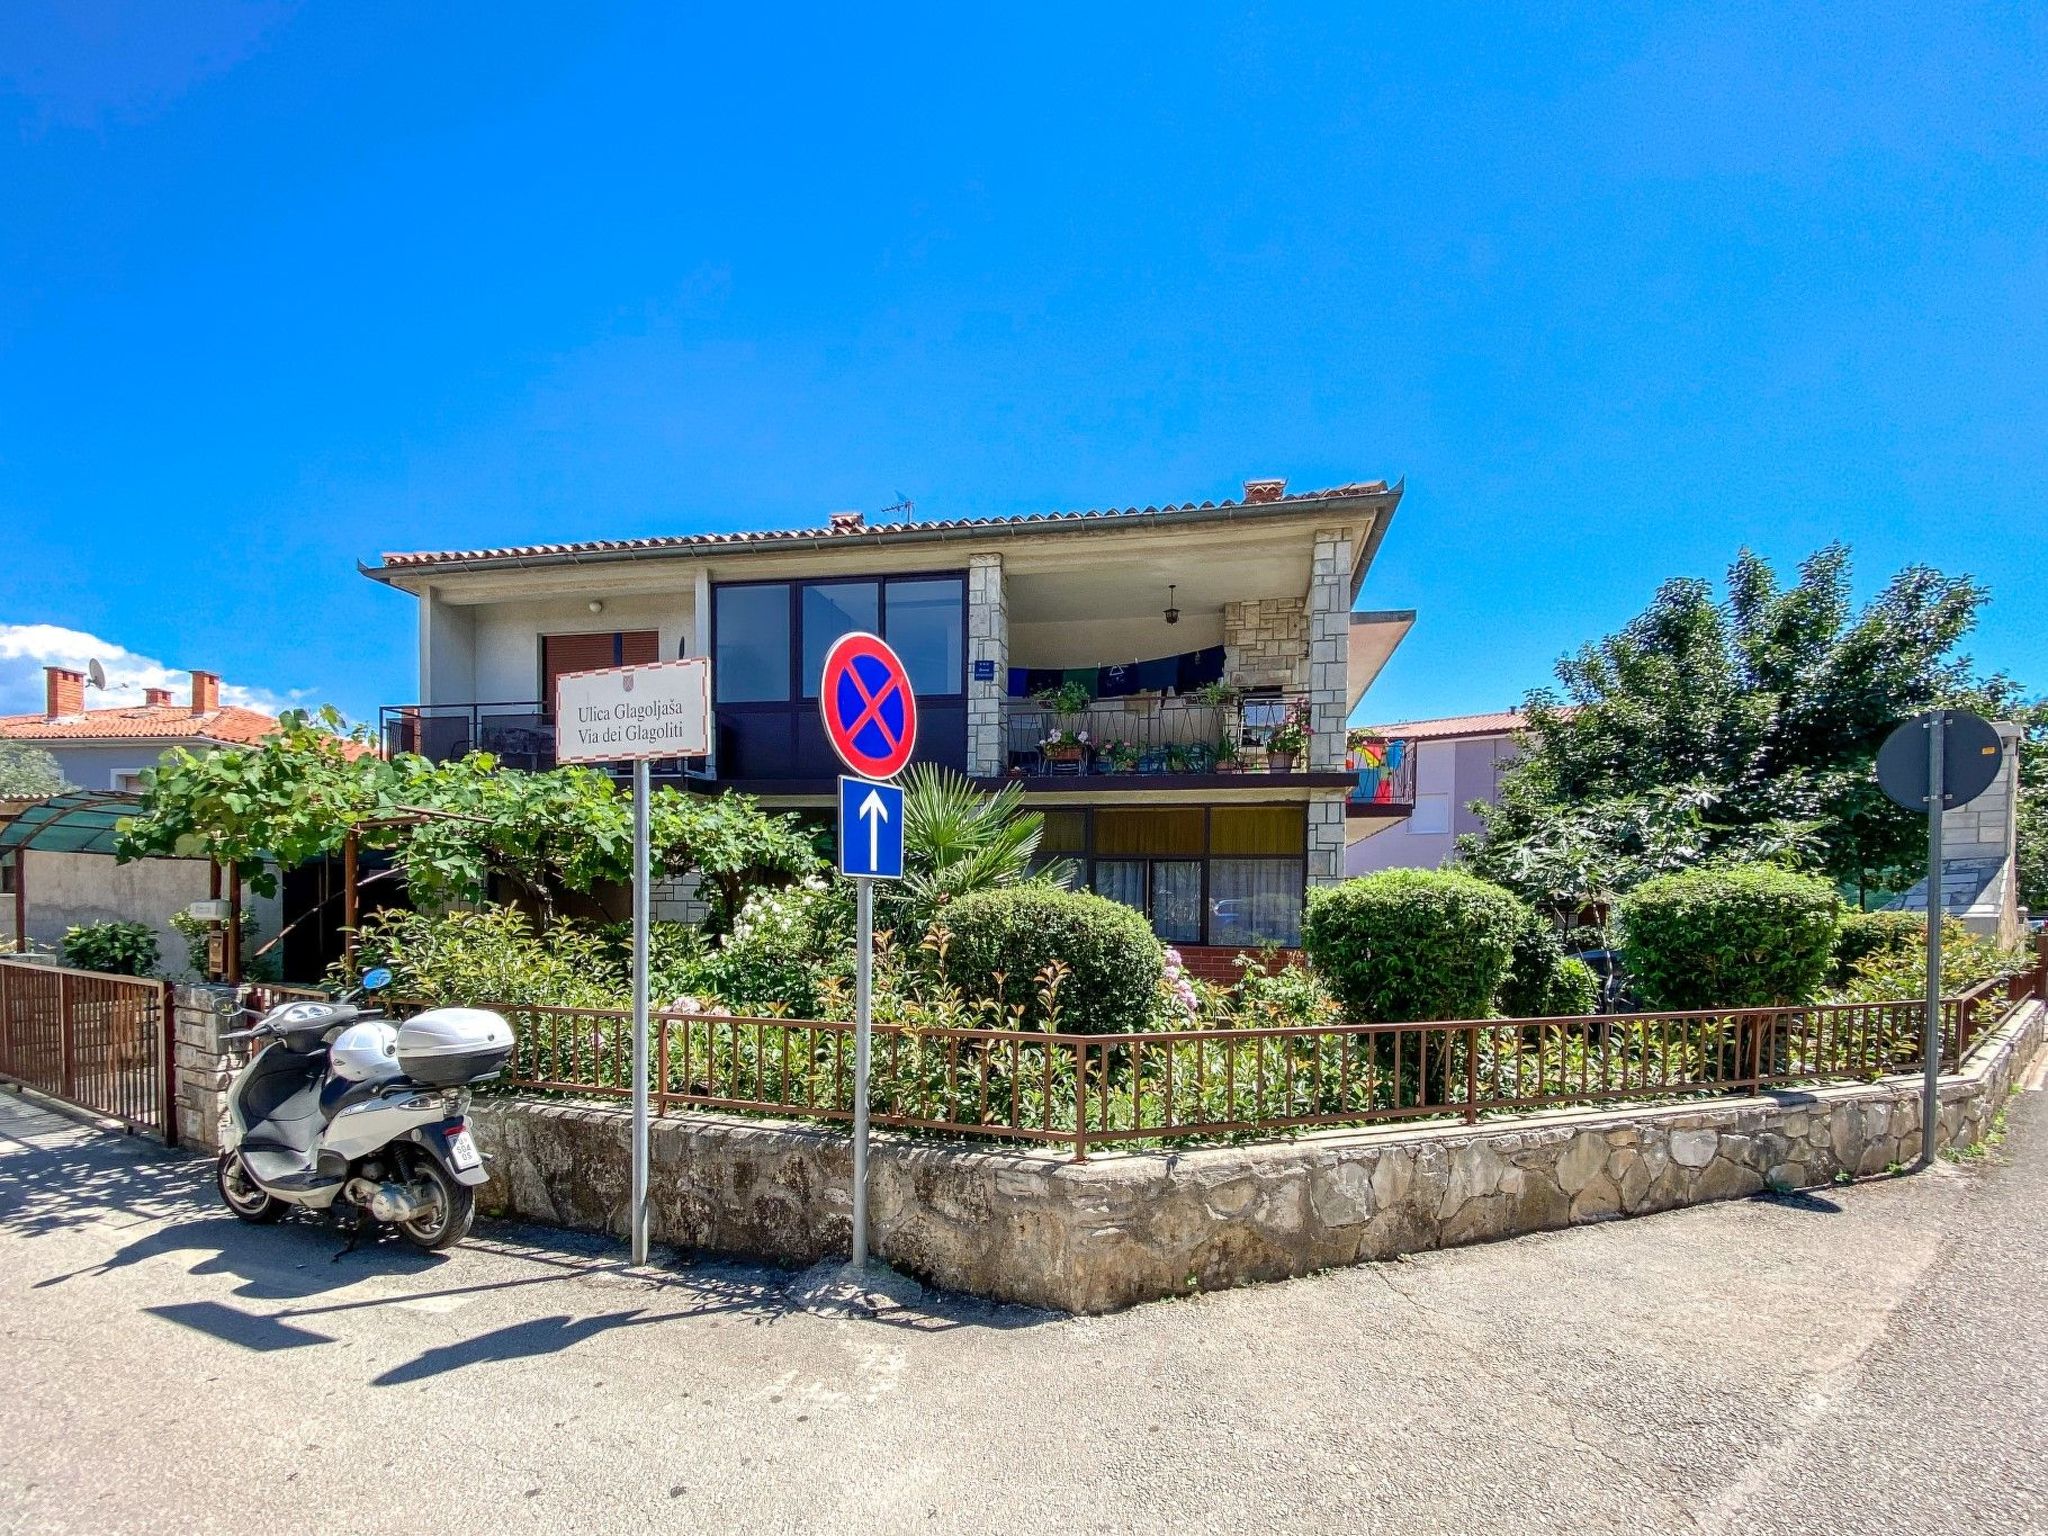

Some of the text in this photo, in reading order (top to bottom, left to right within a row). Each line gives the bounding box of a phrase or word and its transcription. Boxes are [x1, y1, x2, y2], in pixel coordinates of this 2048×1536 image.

[578, 699, 683, 723] Ulica Glagoljaša
[578, 721, 683, 745] Via dei Glagoliti
